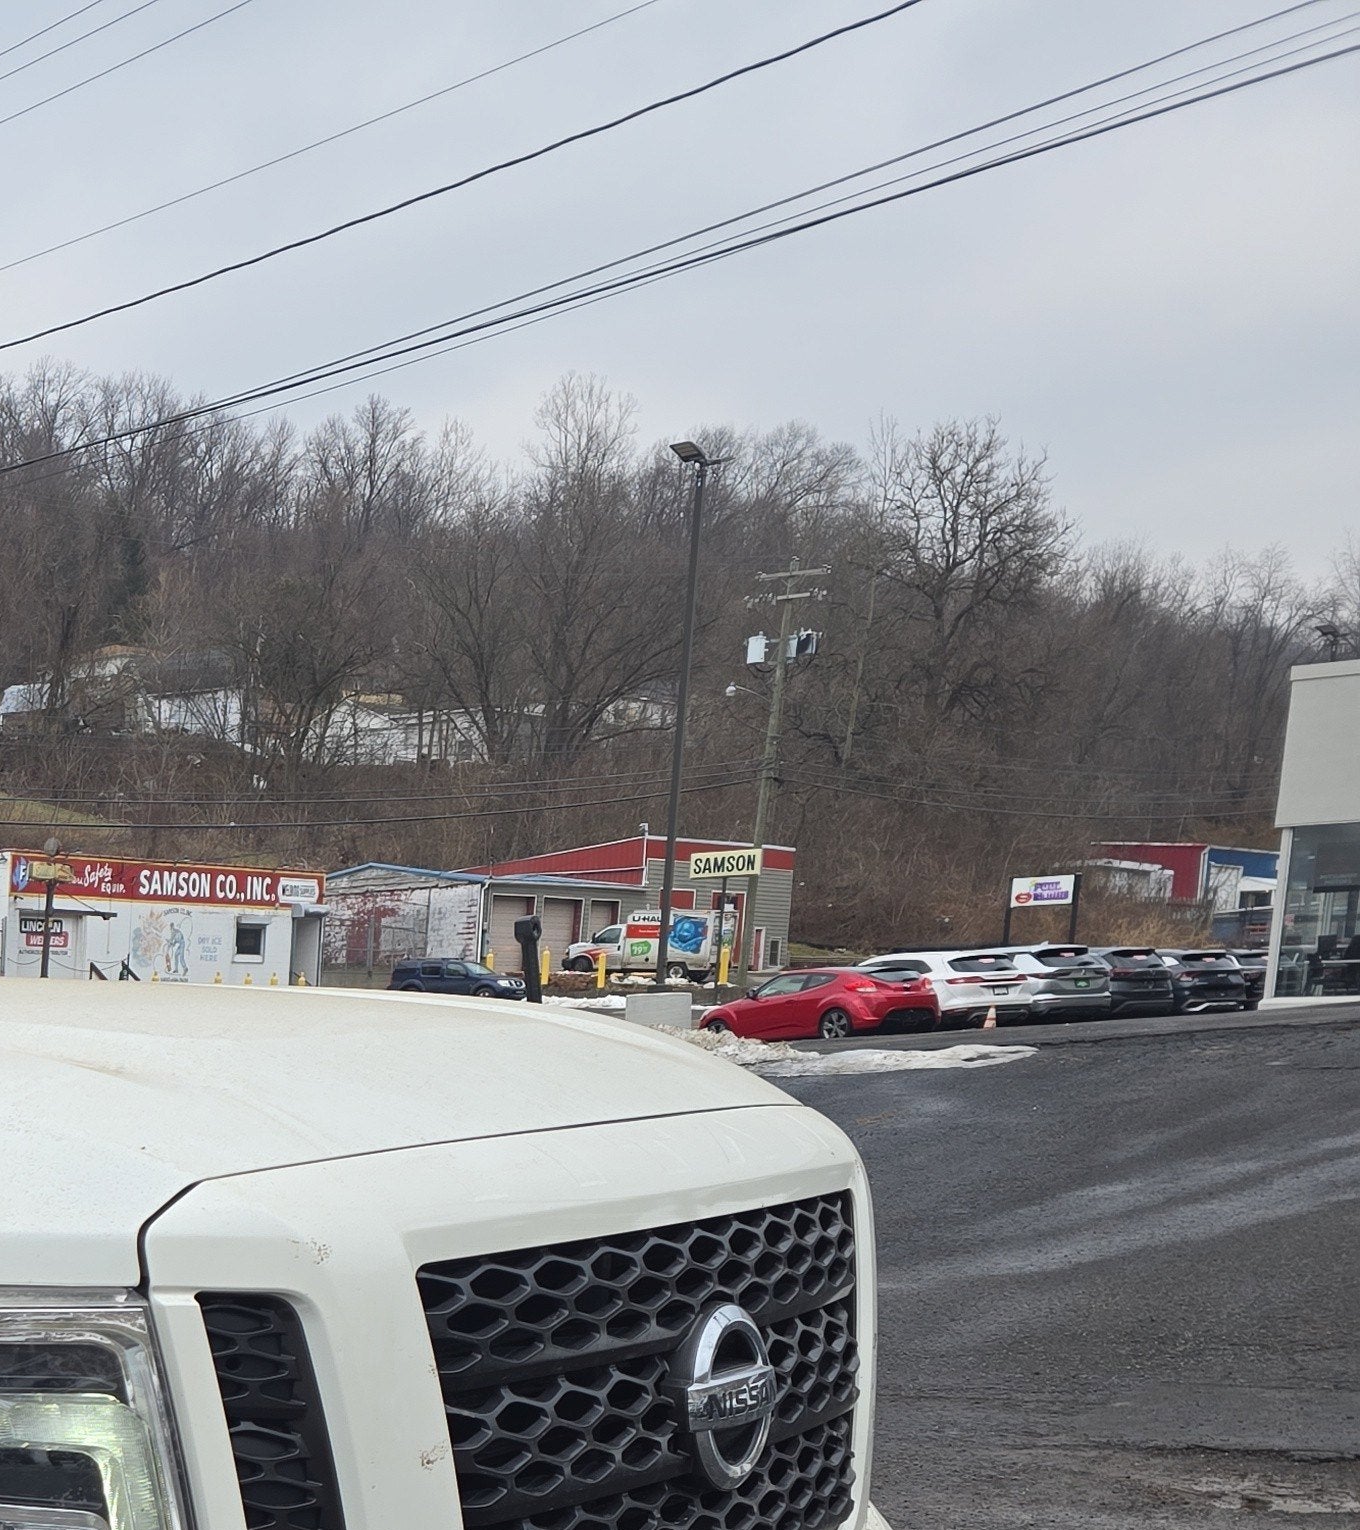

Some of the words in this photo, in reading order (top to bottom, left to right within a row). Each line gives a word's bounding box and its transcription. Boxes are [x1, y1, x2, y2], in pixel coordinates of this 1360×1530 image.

[83, 863, 114, 887] Safety
[693, 854, 756, 875] SAMSON
[138, 869, 211, 899] SAMSON
